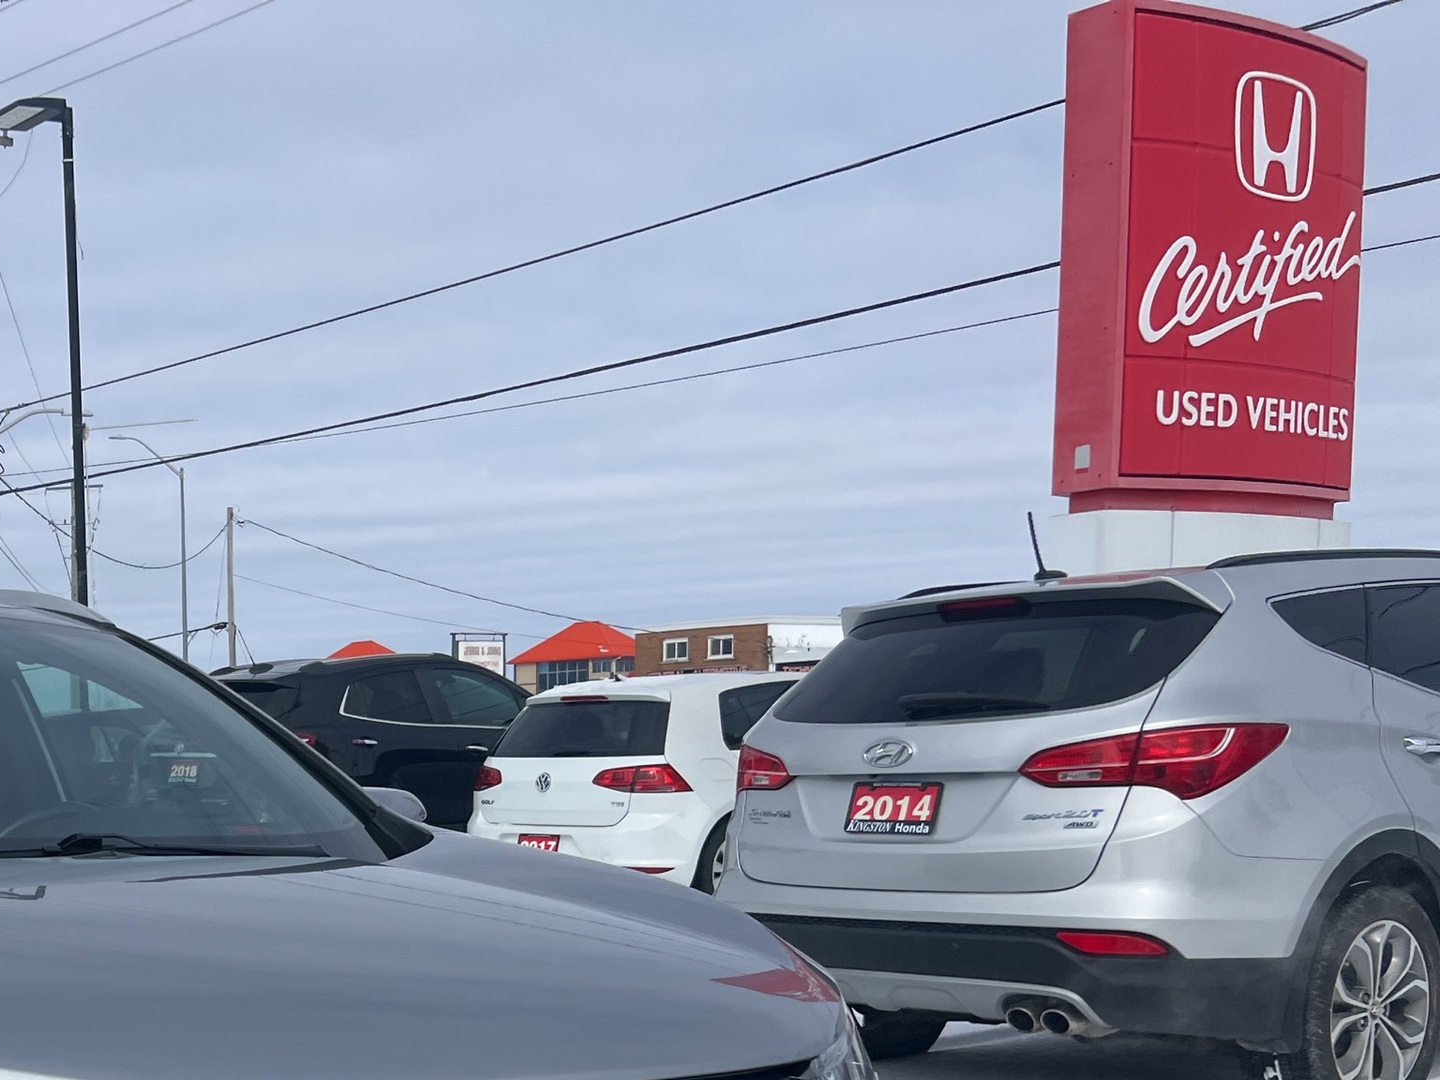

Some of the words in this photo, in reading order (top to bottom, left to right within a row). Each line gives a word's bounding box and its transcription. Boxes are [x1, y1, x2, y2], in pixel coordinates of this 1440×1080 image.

[1138, 211, 1361, 342] Certified
[1156, 390, 1238, 429] USED
[1247, 395, 1349, 441] VEHICLES
[846, 820, 893, 832] KINGSTON
[894, 822, 930, 834] Honda
[853, 795, 931, 821] 2014
